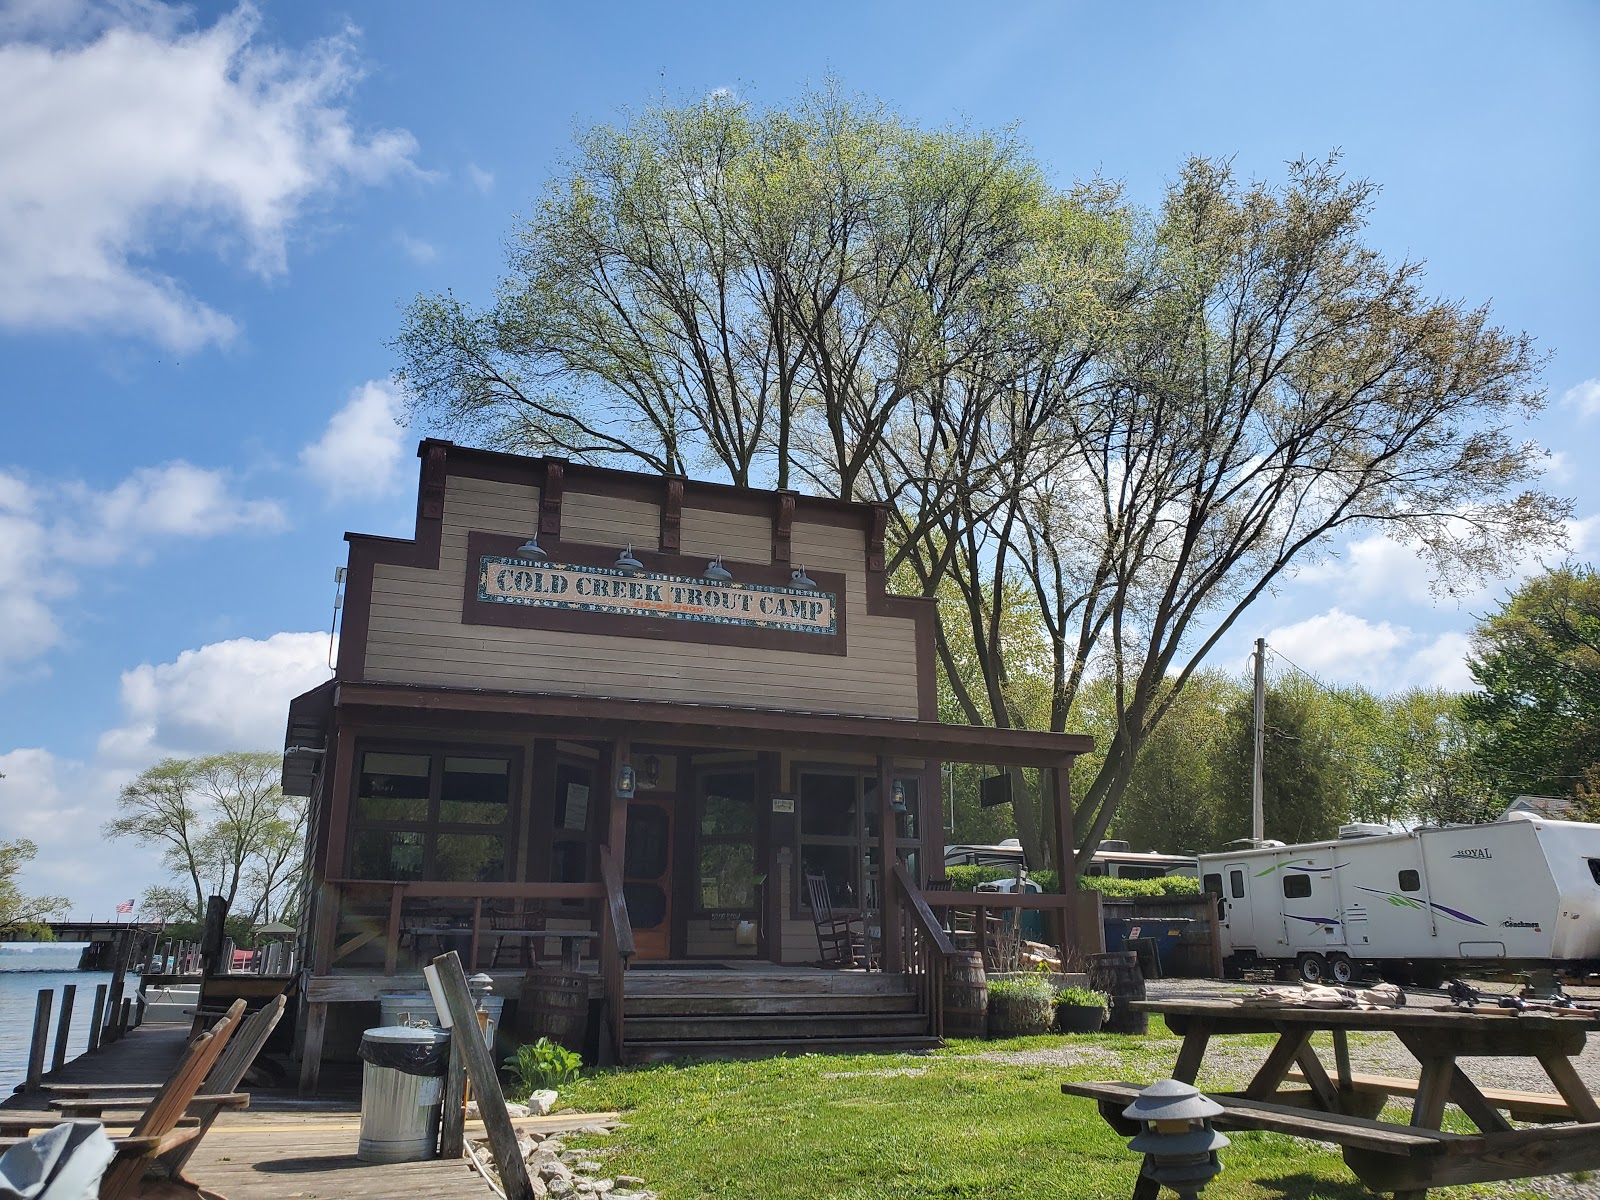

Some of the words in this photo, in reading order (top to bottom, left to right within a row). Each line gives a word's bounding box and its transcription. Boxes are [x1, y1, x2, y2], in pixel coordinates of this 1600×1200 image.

[500, 558, 549, 568] FISHING
[574, 565, 624, 576] TENTING
[650, 573, 681, 582] SLEEP
[496, 569, 568, 594] COLD
[575, 577, 663, 602] CREEK
[670, 586, 753, 612] TROUT
[759, 596, 824, 622] CAMP
[781, 588, 827, 598] HUNTING
[497, 596, 559, 607] DOCKAGE
[1457, 847, 1493, 859] ROYAL
